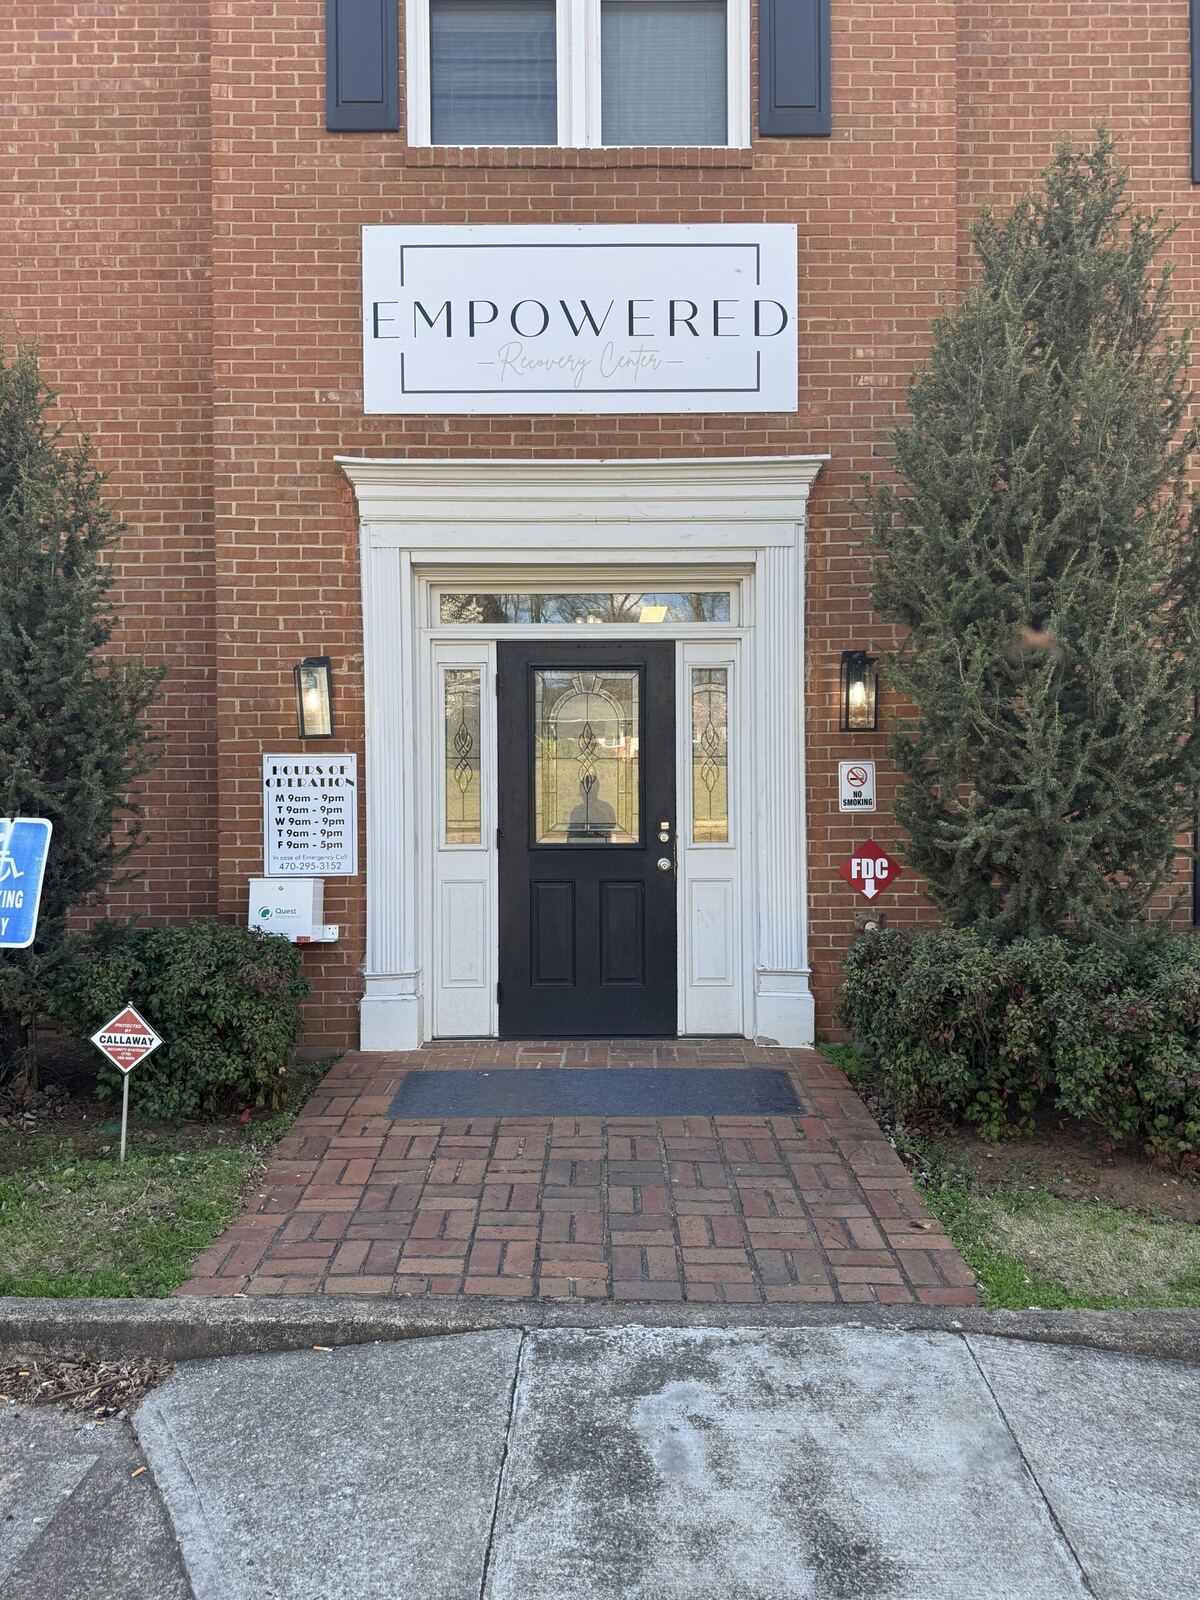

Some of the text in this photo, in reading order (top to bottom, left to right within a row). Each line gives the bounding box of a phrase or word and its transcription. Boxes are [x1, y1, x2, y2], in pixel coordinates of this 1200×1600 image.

[372, 298, 789, 339] EMPOWERED
[498, 340, 662, 389] Recovery Center
[272, 765, 348, 775] HOURS OF
[265, 778, 355, 788] OPERATION
[288, 794, 311, 802] 9am
[322, 794, 344, 803] 9pm
[853, 790, 862, 798] NO
[842, 798, 873, 806] SMOKING
[286, 806, 309, 814] 9am
[320, 806, 342, 815] 9pm
[288, 817, 311, 825] 9am
[322, 817, 345, 827] 9pm
[286, 829, 309, 837] 9am
[320, 829, 342, 838] 9pm
[286, 841, 309, 849] 9am
[320, 841, 343, 850] 5pm
[279, 862, 342, 870] 470-295-3152
[851, 858, 888, 879] FDC
[0, 890, 24, 909] ING
[99, 1035, 154, 1046] CALLAWAY
